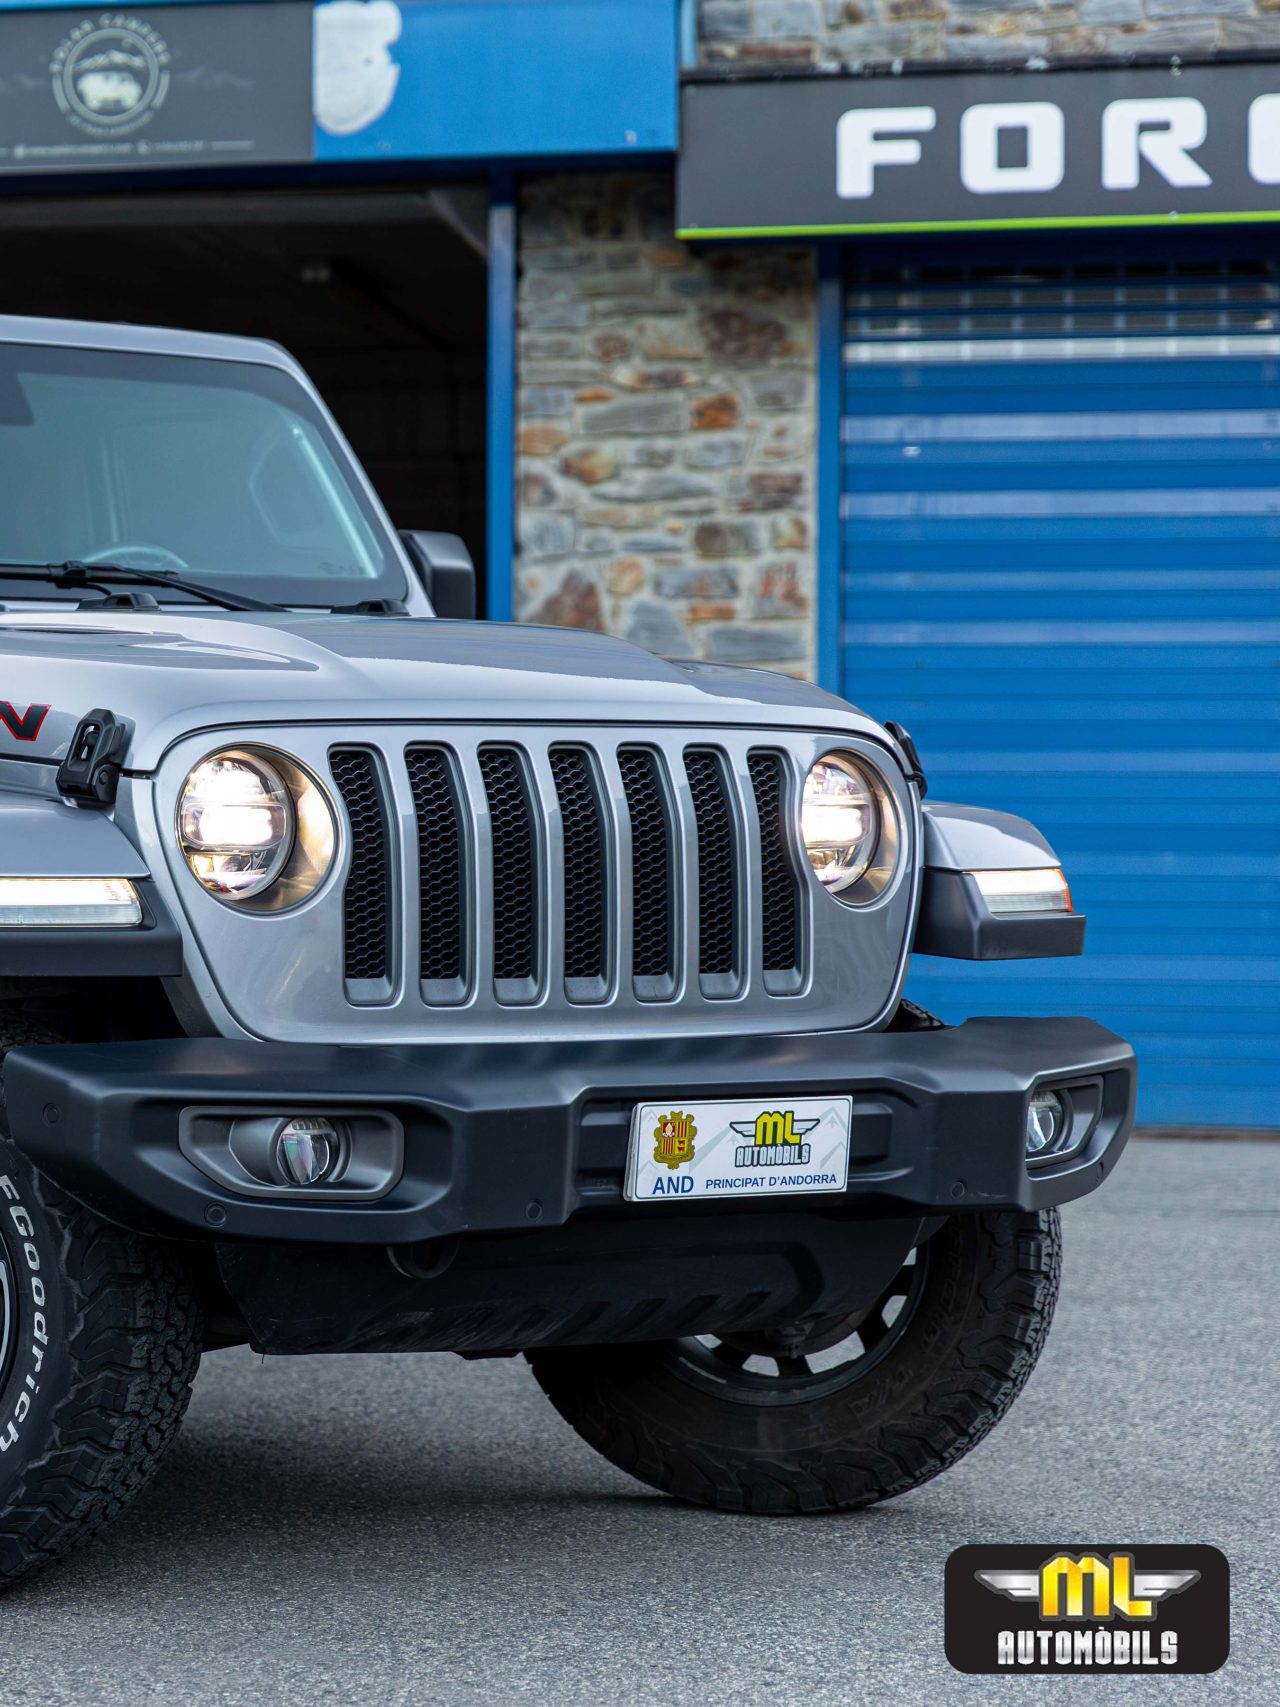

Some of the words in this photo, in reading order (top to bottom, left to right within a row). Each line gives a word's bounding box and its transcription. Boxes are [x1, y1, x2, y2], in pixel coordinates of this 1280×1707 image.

[755, 1110, 802, 1145] ML
[652, 1175, 694, 1195] AND
[705, 1176, 766, 1190] PRINCIPAT
